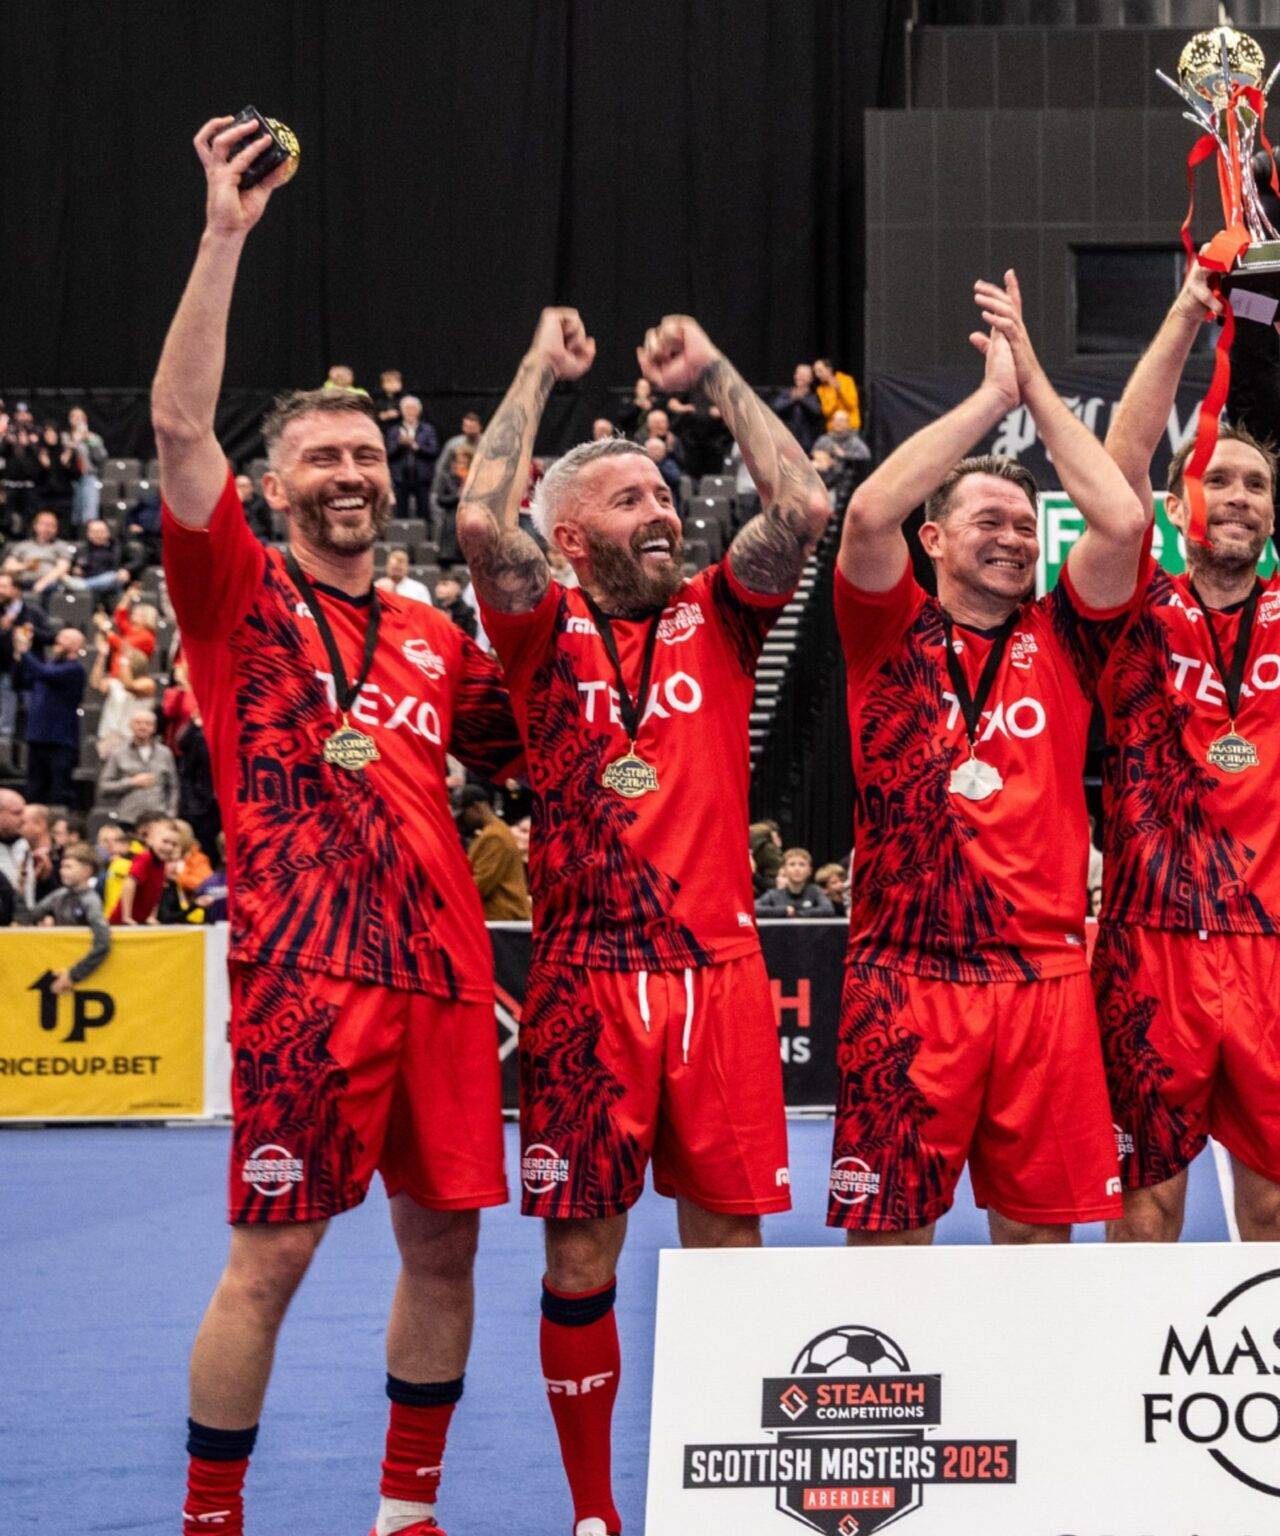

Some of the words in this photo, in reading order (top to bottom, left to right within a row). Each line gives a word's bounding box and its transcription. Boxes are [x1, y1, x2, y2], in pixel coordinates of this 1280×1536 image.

[942, 692, 1046, 742] TXO
[816, 1383, 925, 1405] STEALTH
[816, 1406, 924, 1419] COMPETITIONS
[691, 1448, 811, 1483] SCOTTISH
[821, 1446, 935, 1480] MASTERS
[943, 1445, 1009, 1479] 2025
[808, 1491, 891, 1506] ABERDEEN
